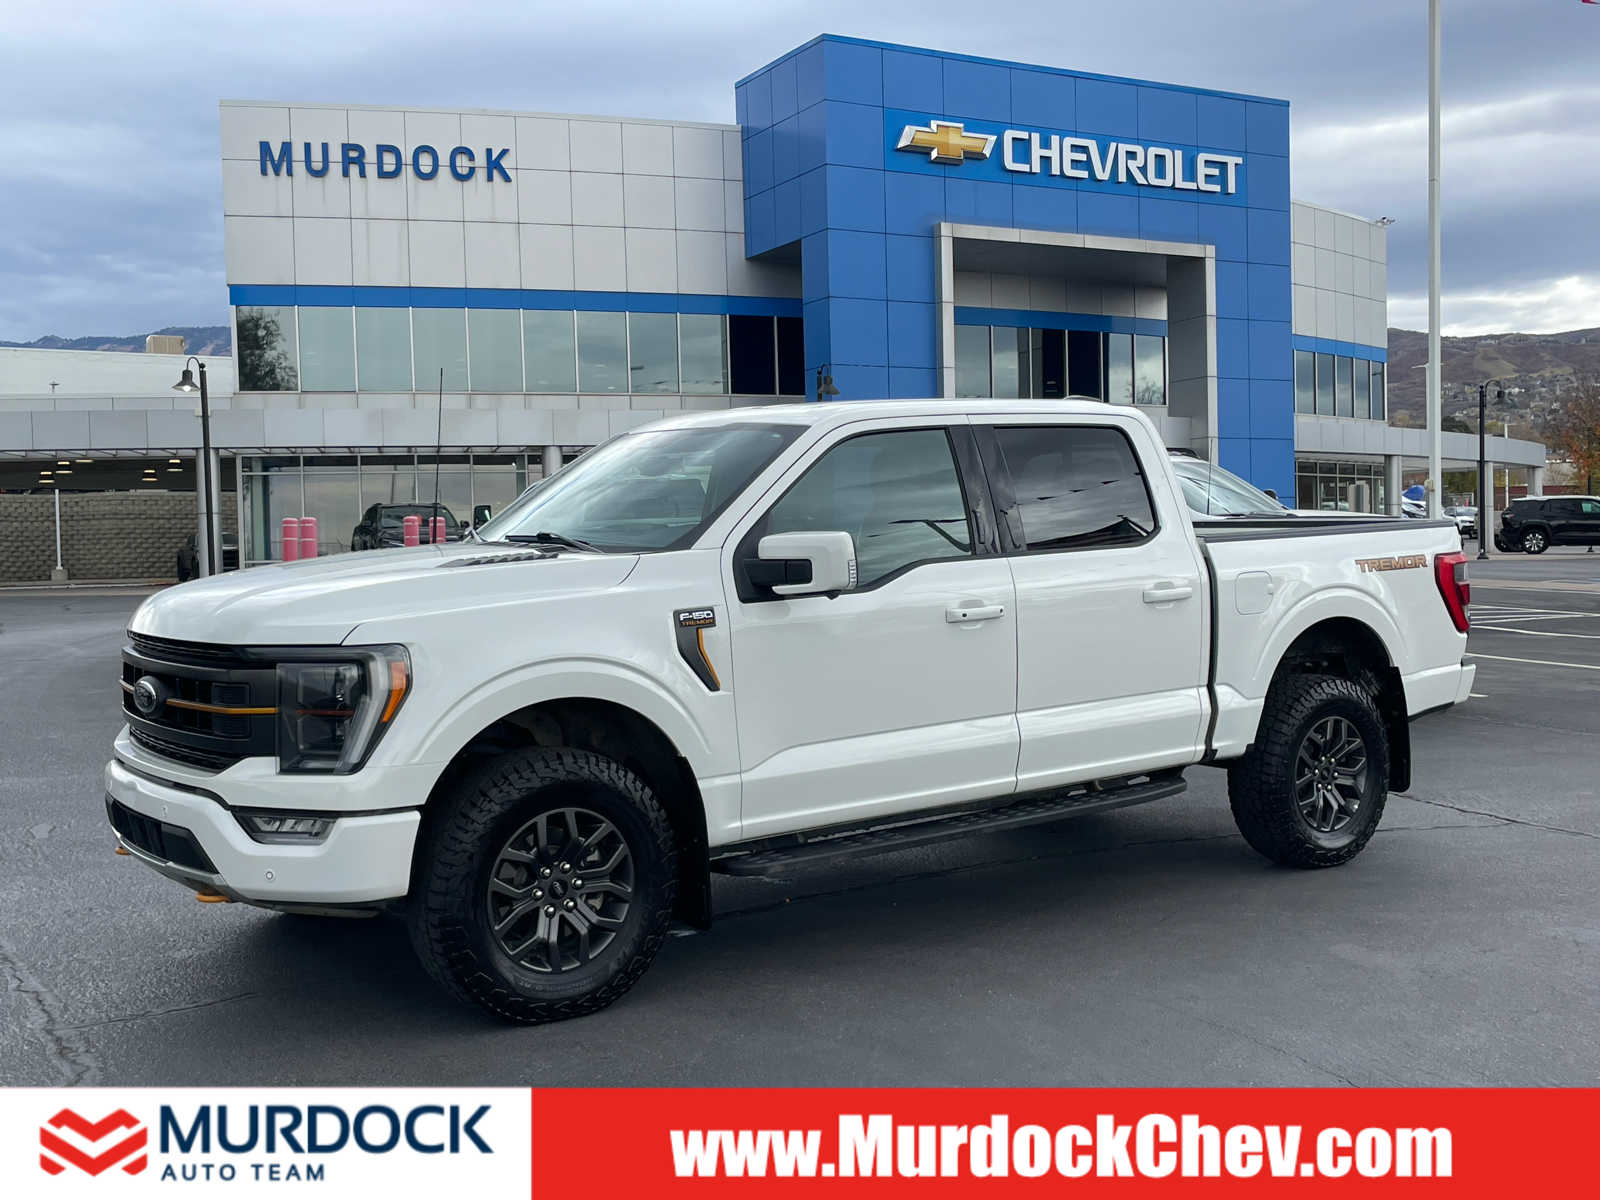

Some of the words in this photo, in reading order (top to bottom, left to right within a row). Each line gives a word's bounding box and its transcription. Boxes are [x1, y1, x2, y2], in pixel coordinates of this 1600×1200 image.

[259, 141, 512, 182] MURDOCK
[1003, 129, 1243, 194] CHEVROLET
[1355, 554, 1427, 573] TREMOR
[680, 611, 713, 621] F-150
